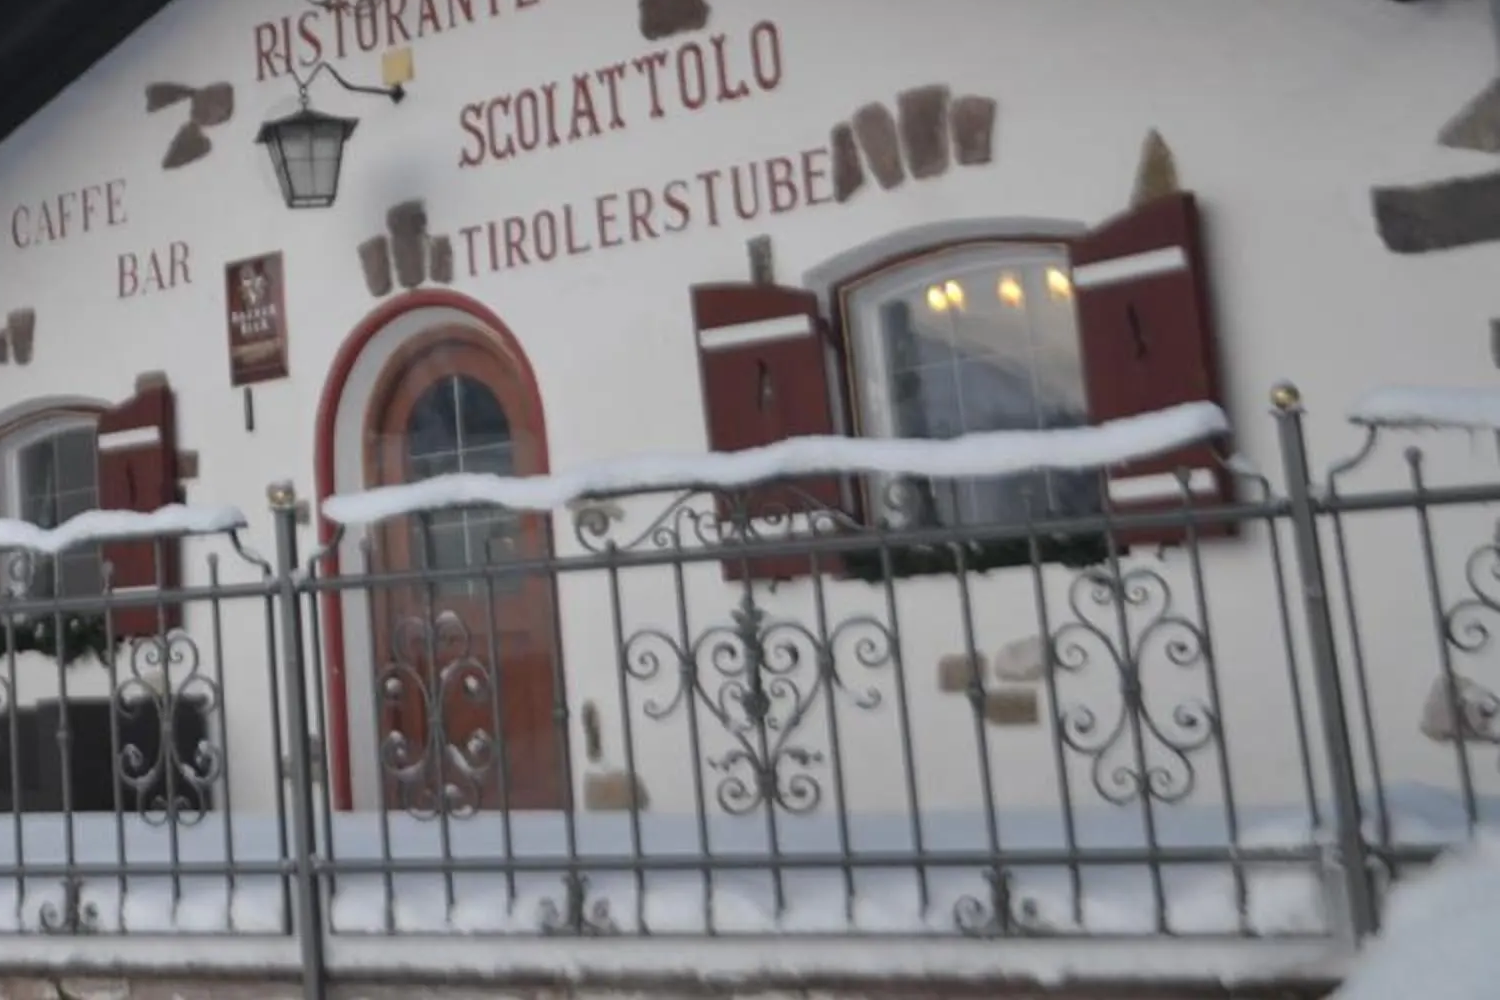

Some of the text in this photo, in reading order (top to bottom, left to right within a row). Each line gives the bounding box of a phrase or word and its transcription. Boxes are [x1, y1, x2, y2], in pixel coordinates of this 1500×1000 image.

[458, 20, 782, 168] SCOIATTOLO
[11, 178, 129, 249] CAFFE
[459, 147, 835, 278] TIROLERSTUBE
[117, 240, 192, 299] BAR
